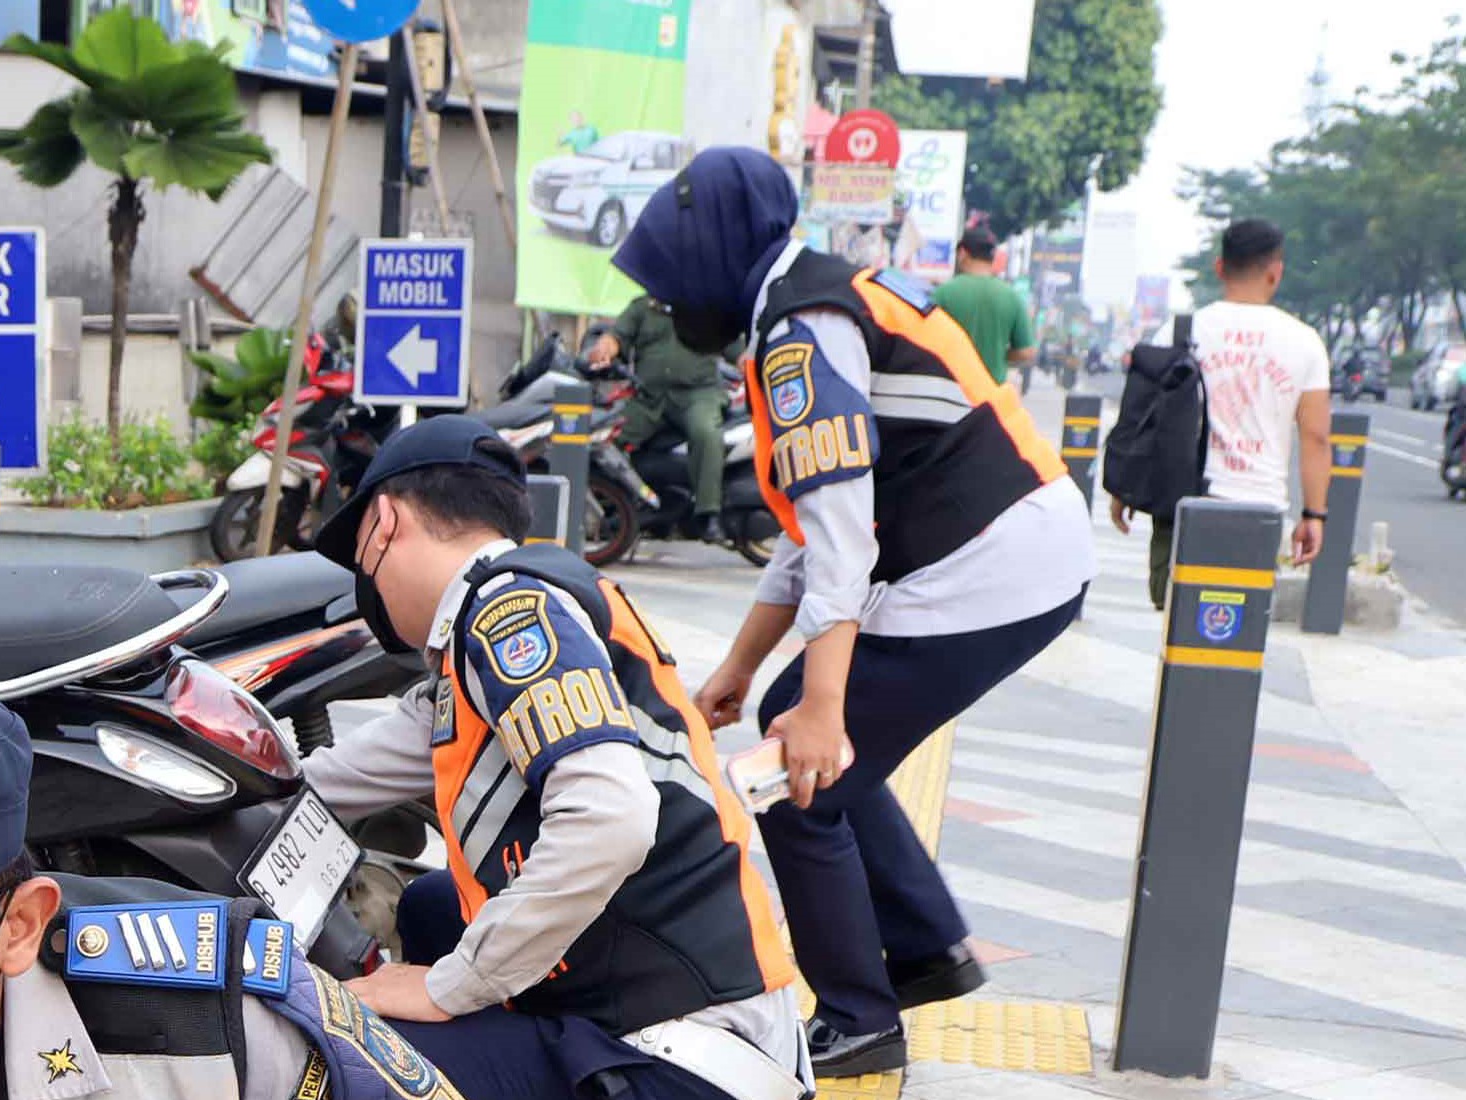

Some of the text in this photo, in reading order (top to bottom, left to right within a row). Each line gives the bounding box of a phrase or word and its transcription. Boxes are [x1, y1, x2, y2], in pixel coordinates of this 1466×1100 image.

[373, 253, 455, 278] MASUK
[378, 280, 448, 306] MOBIL
[252, 799, 329, 908] B 4982 TLD
[195, 912, 217, 973] DISHUB
[262, 925, 284, 980] DISHUB
[301, 1052, 326, 1100] PEMPR
